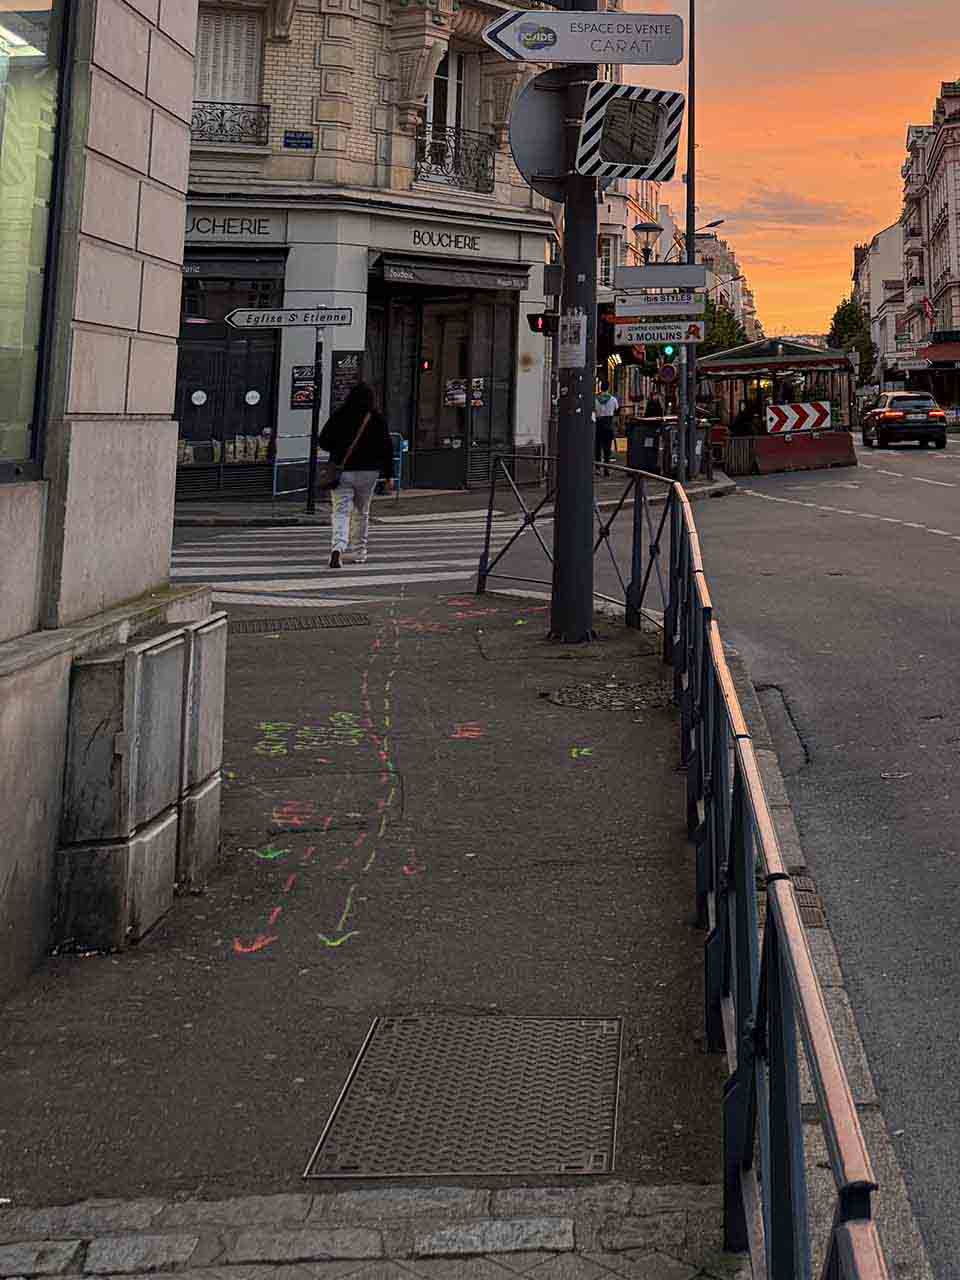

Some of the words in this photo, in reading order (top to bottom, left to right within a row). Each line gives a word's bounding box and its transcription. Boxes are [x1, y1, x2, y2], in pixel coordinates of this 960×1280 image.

[570, 22, 614, 34] ESPACE
[616, 23, 633, 34] DE
[634, 23, 672, 35] VENTE
[590, 39, 652, 54] CARAT
[412, 230, 481, 251] BOUCHERIE
[659, 294, 692, 302] STYLES
[246, 313, 283, 324] Eglise
[303, 312, 347, 323] Etienne
[627, 334, 634, 342] 3
[636, 331, 682, 342] MOULINS
